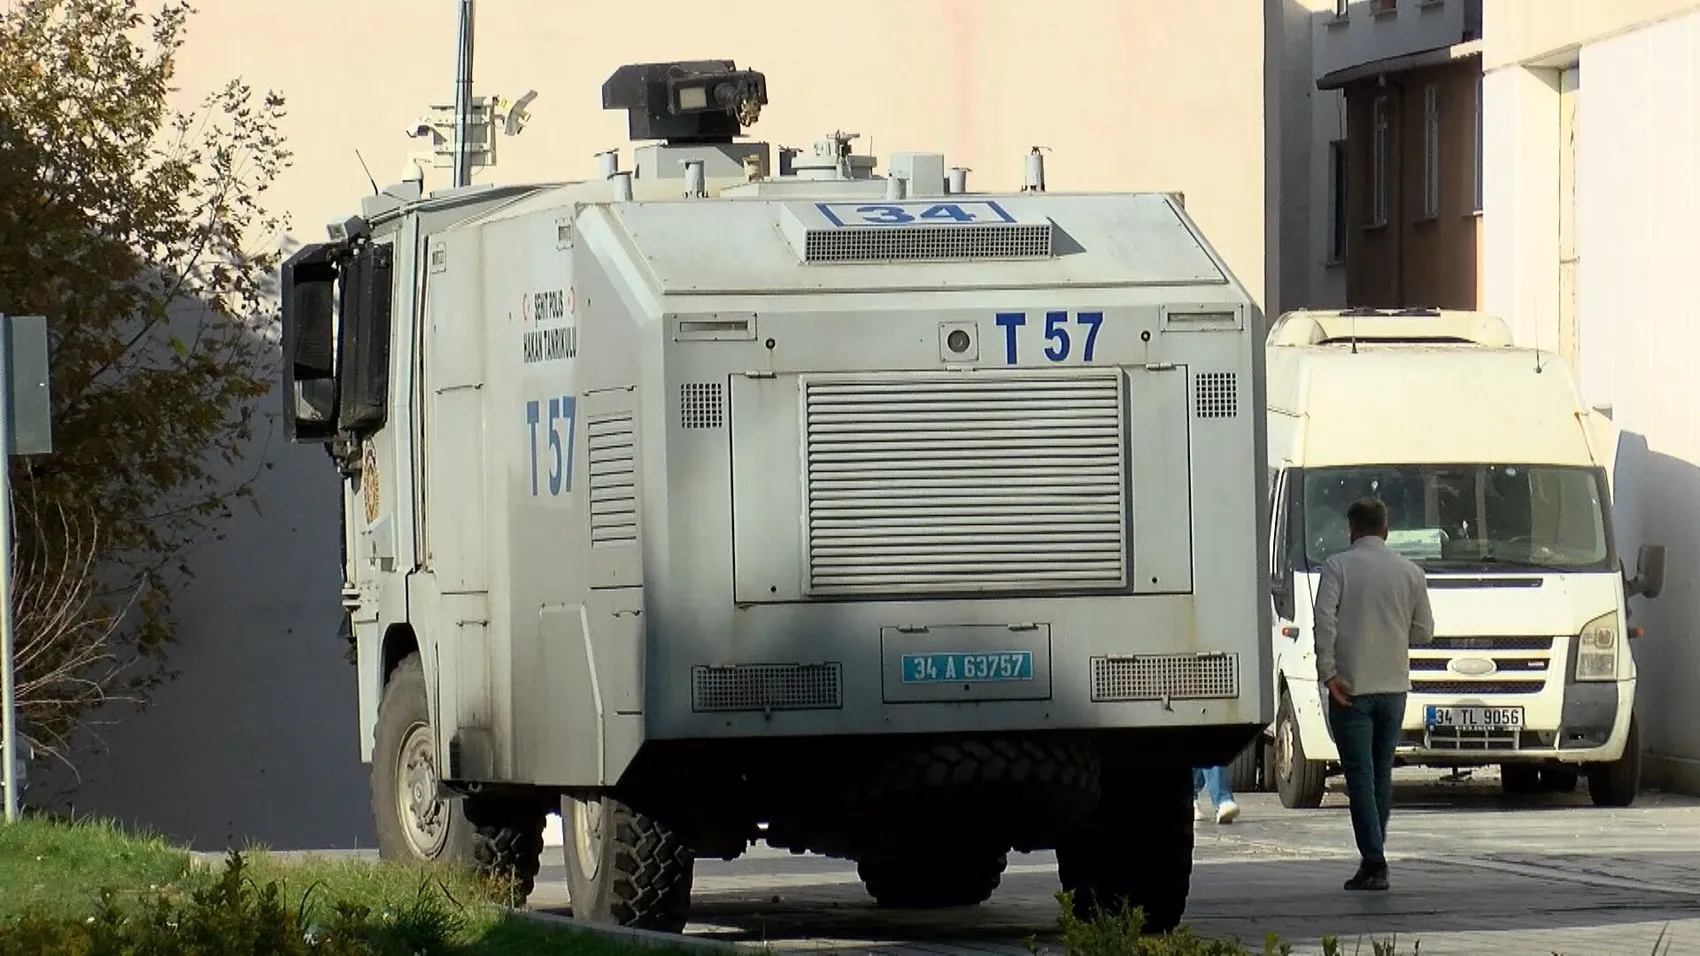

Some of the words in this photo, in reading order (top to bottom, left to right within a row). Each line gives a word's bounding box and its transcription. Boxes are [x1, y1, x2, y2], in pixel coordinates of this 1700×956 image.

[856, 204, 976, 223] 34
[523, 331, 543, 363] HAKAN
[996, 312, 1026, 364] T
[1044, 311, 1104, 362] 57
[526, 400, 540, 496] T
[549, 396, 577, 496] 57
[914, 657, 937, 679] 34
[945, 656, 957, 679] A
[964, 654, 1023, 678] 63757
[1436, 709, 1453, 725] 34
[1461, 709, 1478, 725] TL
[1484, 709, 1520, 725] 9056
